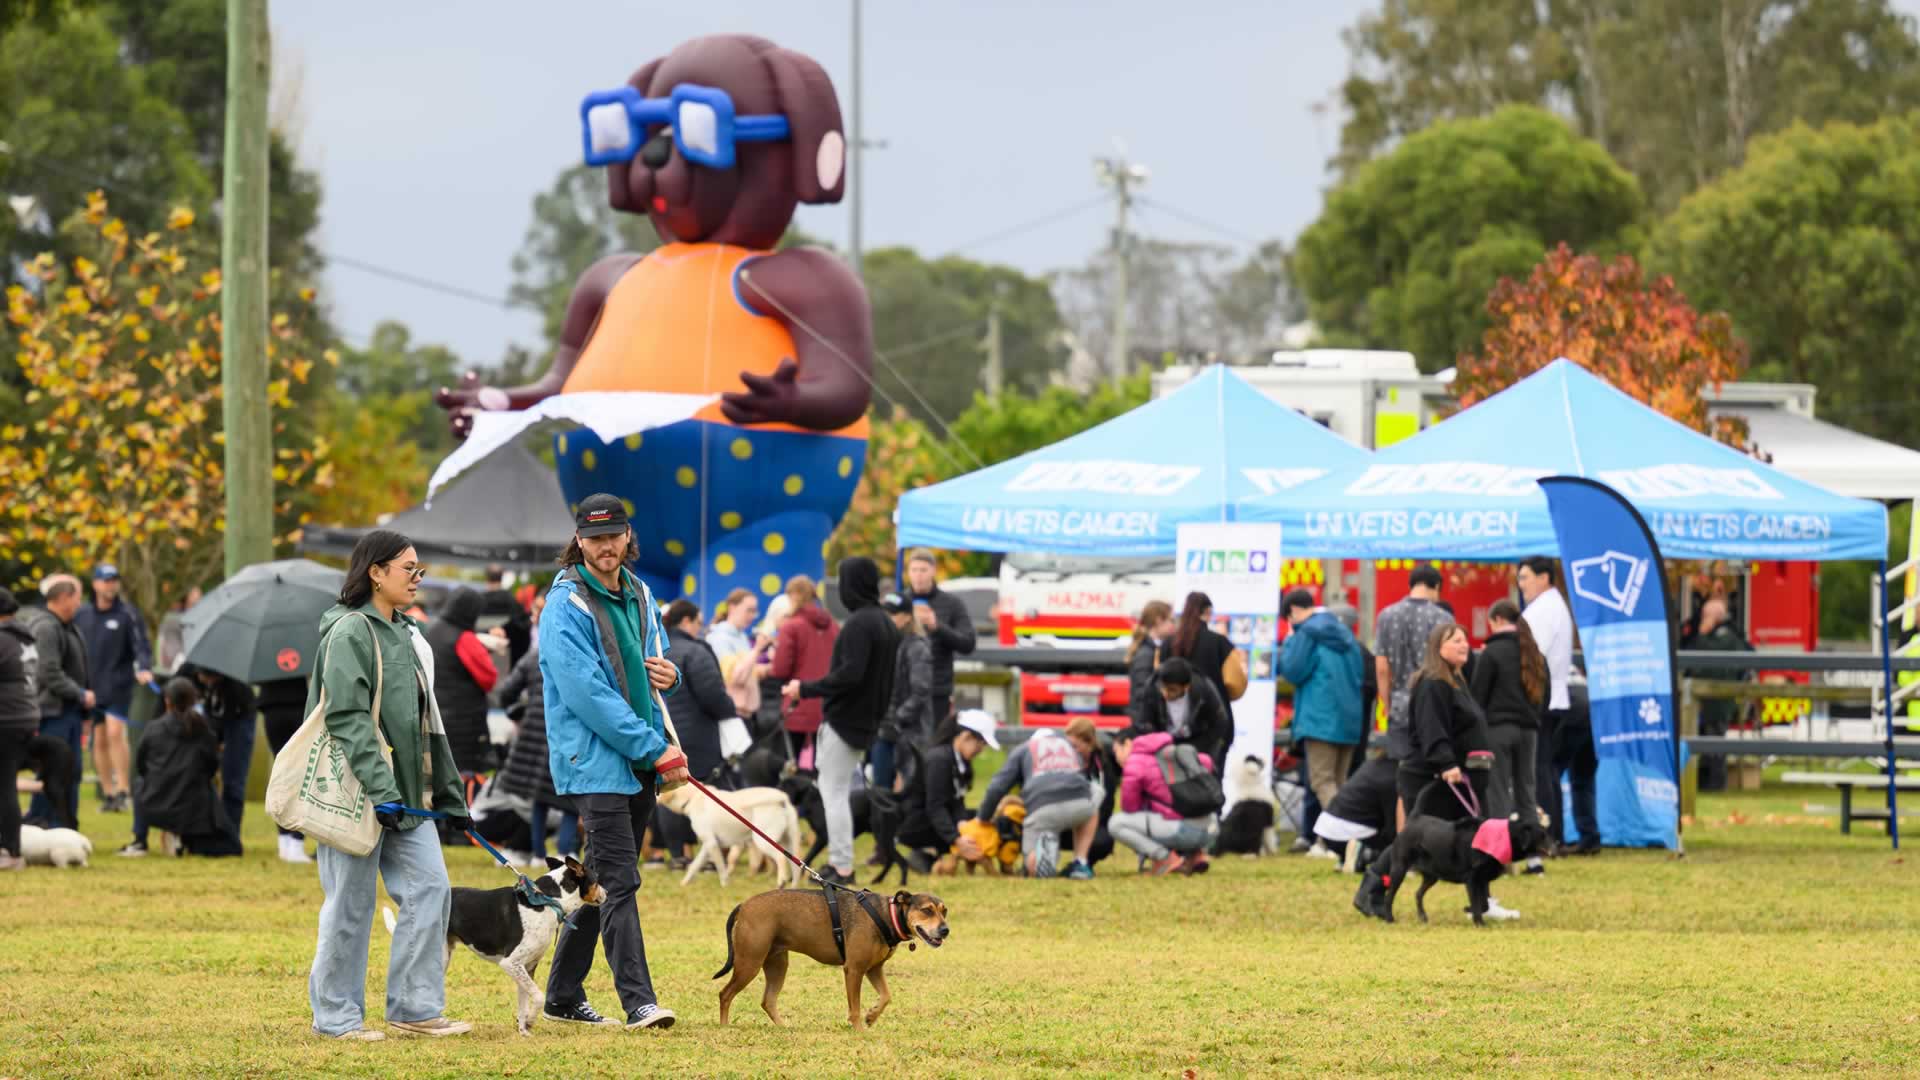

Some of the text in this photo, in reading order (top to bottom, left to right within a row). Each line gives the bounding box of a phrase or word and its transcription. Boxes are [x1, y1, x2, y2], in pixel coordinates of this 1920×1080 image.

[961, 509, 1159, 537] UNI VETS CAMDEN
[1304, 511, 1519, 537] UNI VETS CAMDEN
[1652, 511, 1831, 540] UNI VETS CAMDEN
[1047, 591, 1126, 609] HAZMAT
